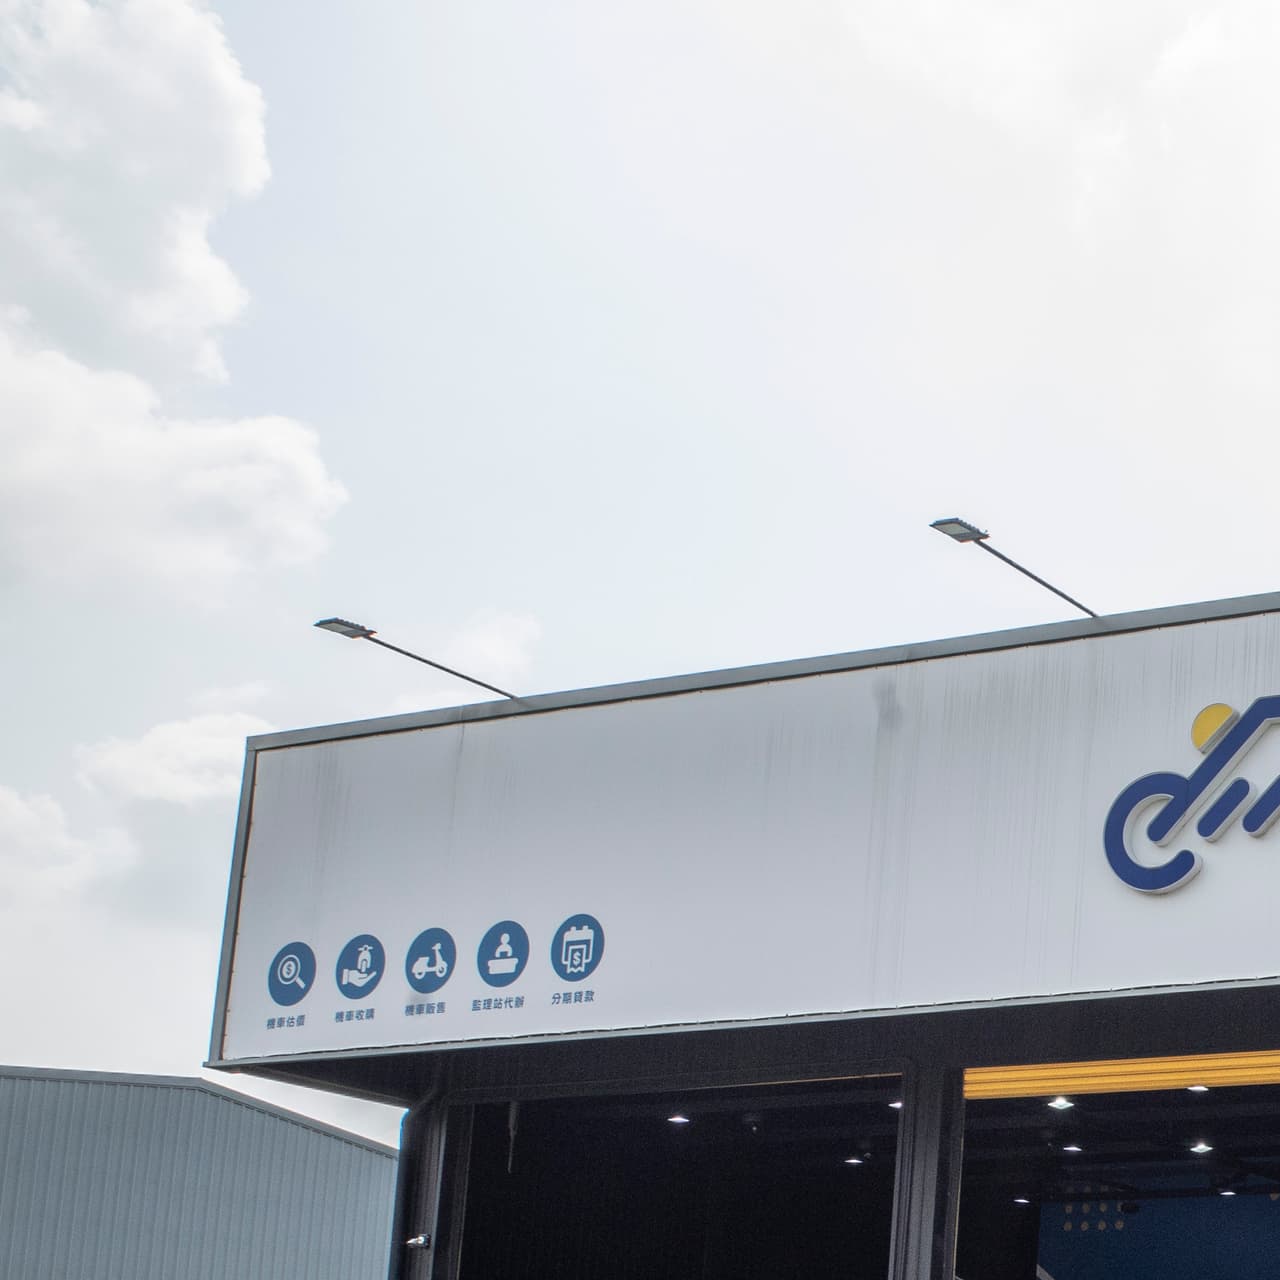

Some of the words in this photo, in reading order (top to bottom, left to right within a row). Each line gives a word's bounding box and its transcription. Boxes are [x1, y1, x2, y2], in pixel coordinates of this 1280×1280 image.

[471, 996, 525, 1011] 監理站代辦
[551, 990, 595, 1005] 分期貸款
[335, 1008, 375, 1023] 機車收購
[404, 1002, 446, 1016] 機車販售
[266, 1014, 306, 1030] 機車估價
